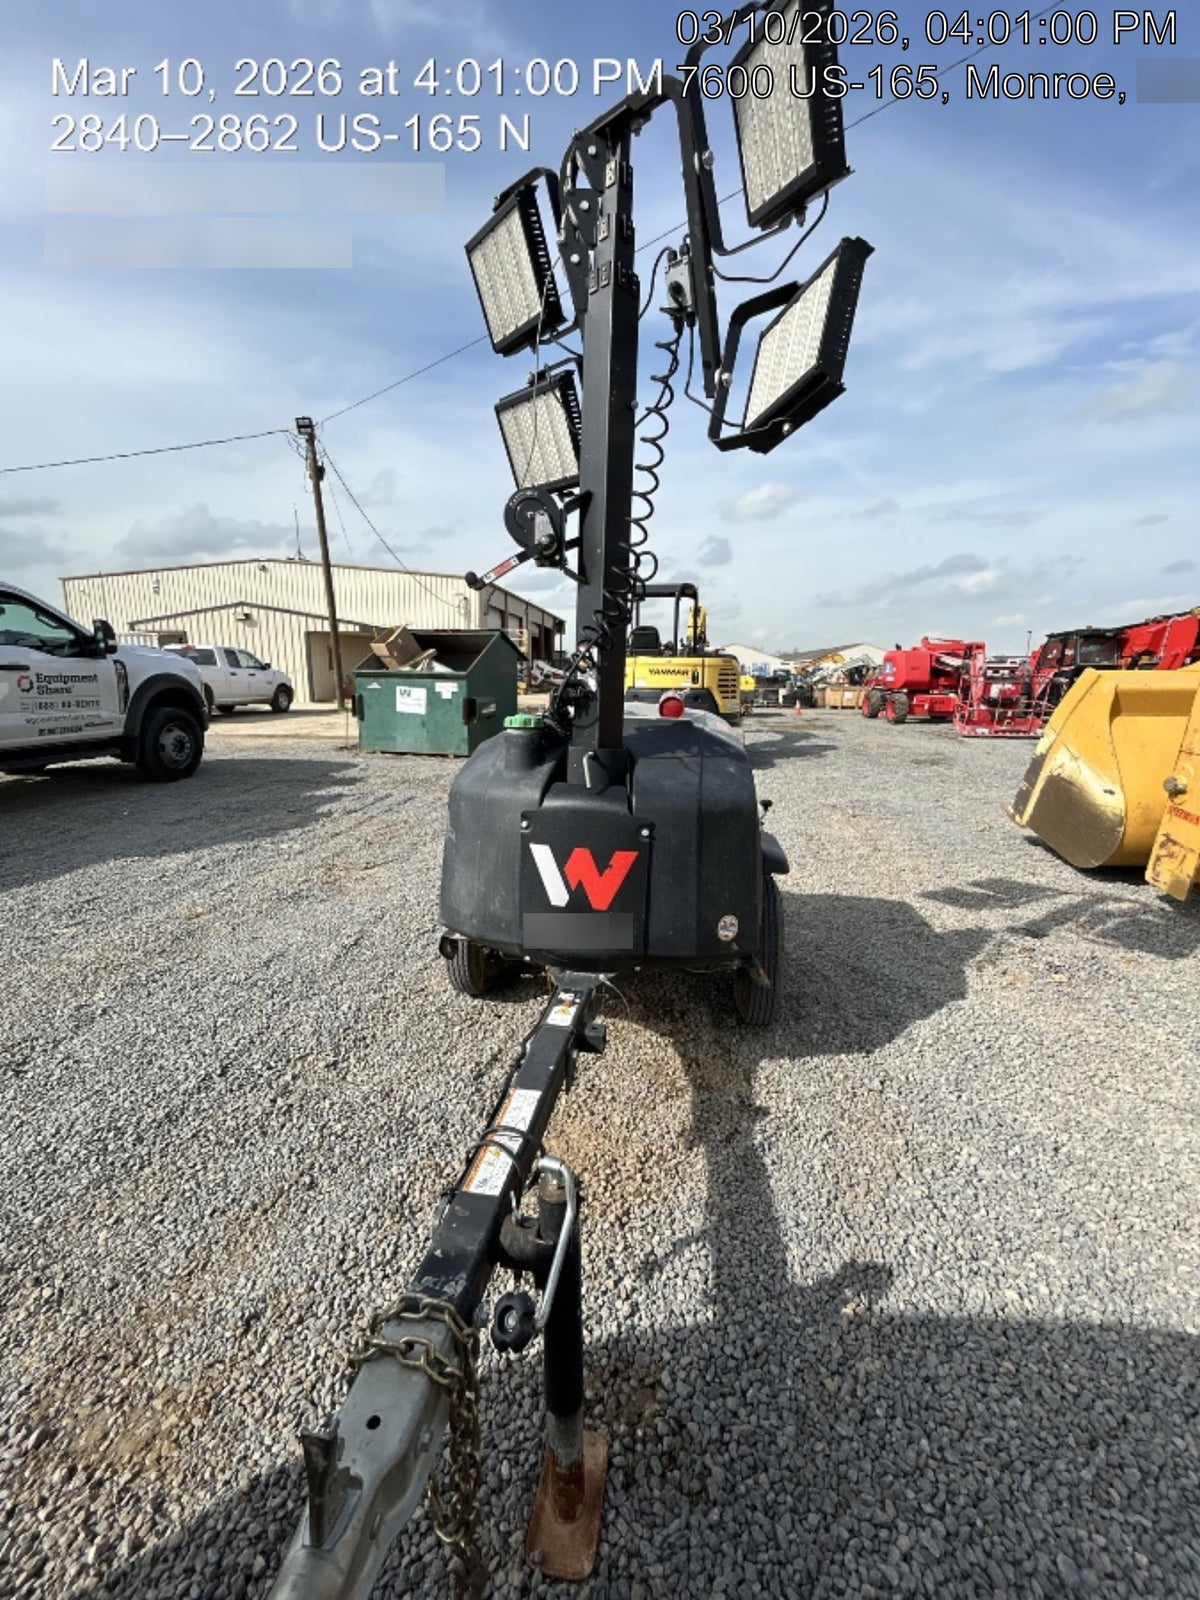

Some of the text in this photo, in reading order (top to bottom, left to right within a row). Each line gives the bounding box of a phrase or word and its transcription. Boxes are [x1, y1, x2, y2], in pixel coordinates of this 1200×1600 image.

[648, 667, 690, 676] YANMAR
[35, 673, 98, 684] Equipment
[36, 685, 72, 695] Share
